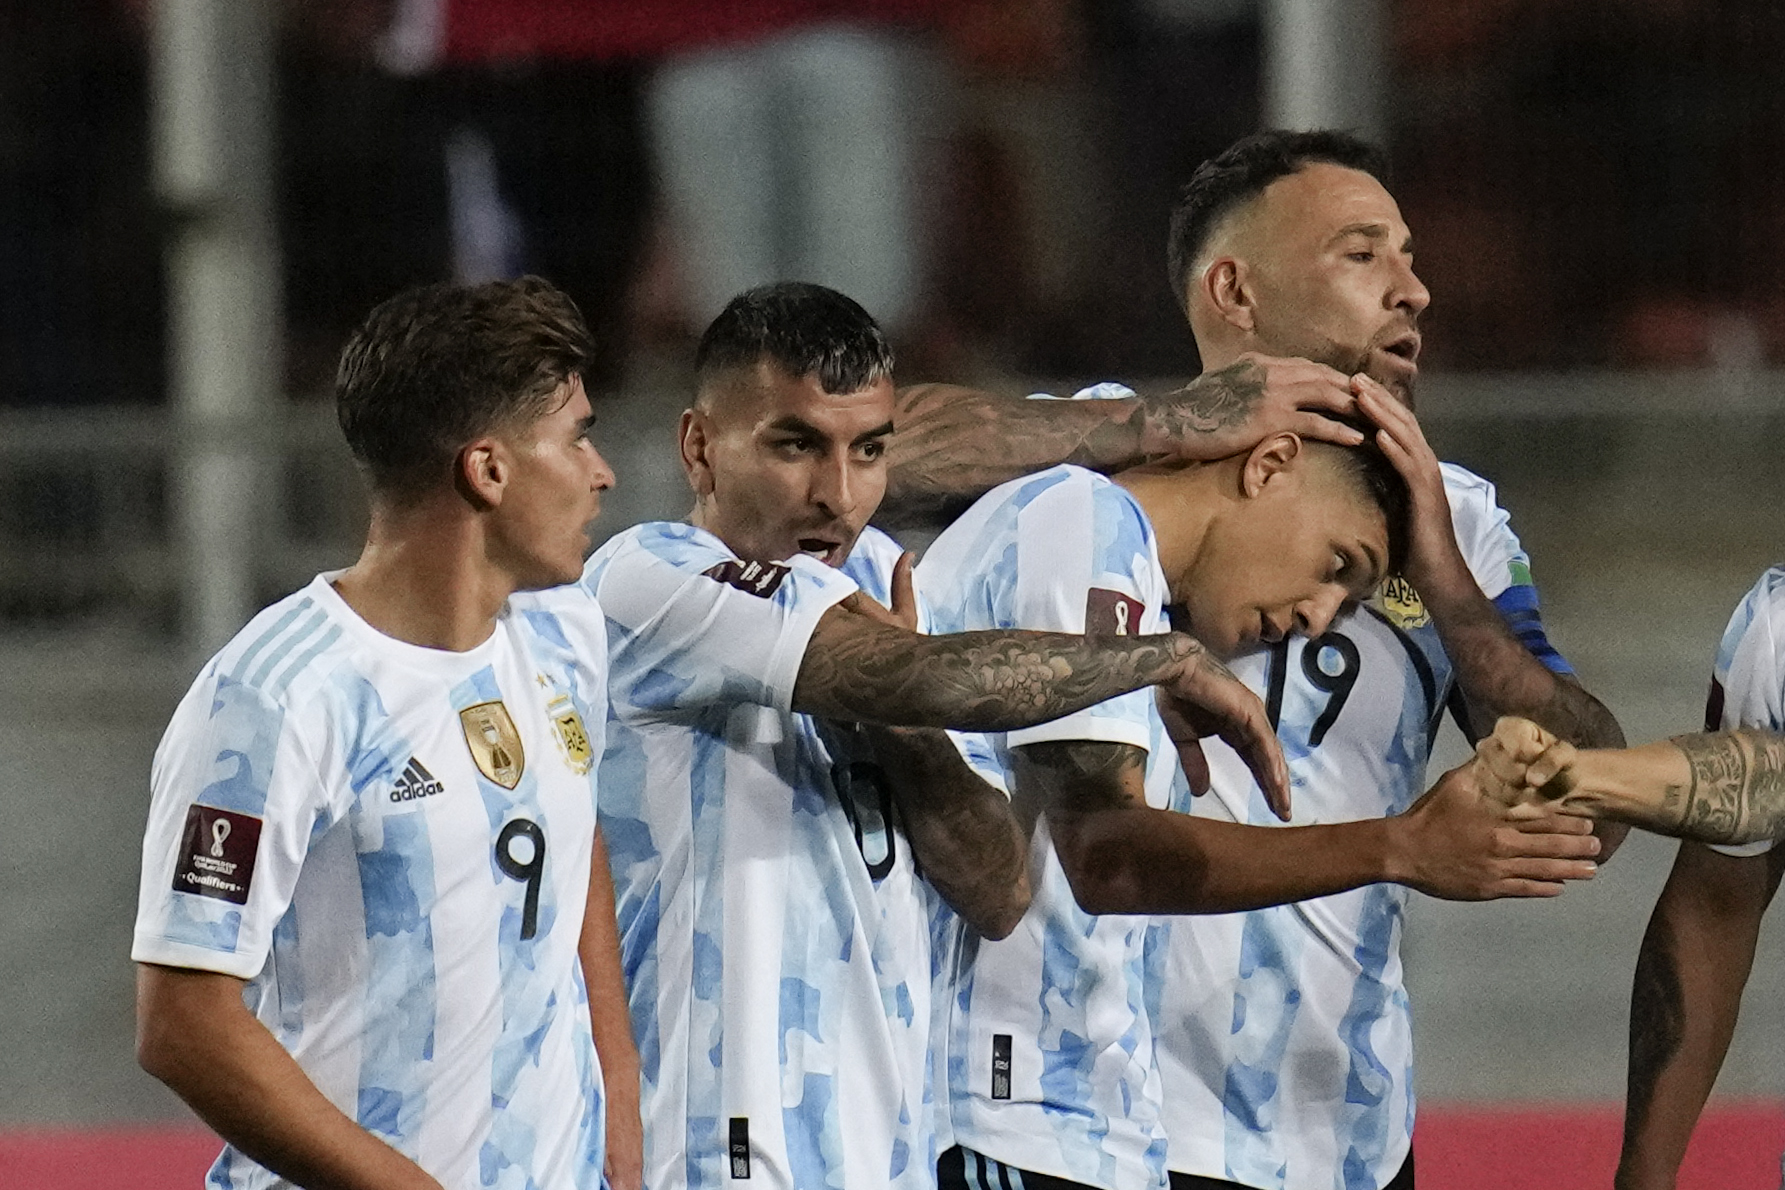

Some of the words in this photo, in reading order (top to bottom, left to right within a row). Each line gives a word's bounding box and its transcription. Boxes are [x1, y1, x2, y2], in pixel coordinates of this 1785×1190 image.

[1265, 631, 1361, 748] 19
[389, 780, 445, 803] adidas
[187, 872, 236, 892] Qualifiers
[495, 818, 546, 941] 9
